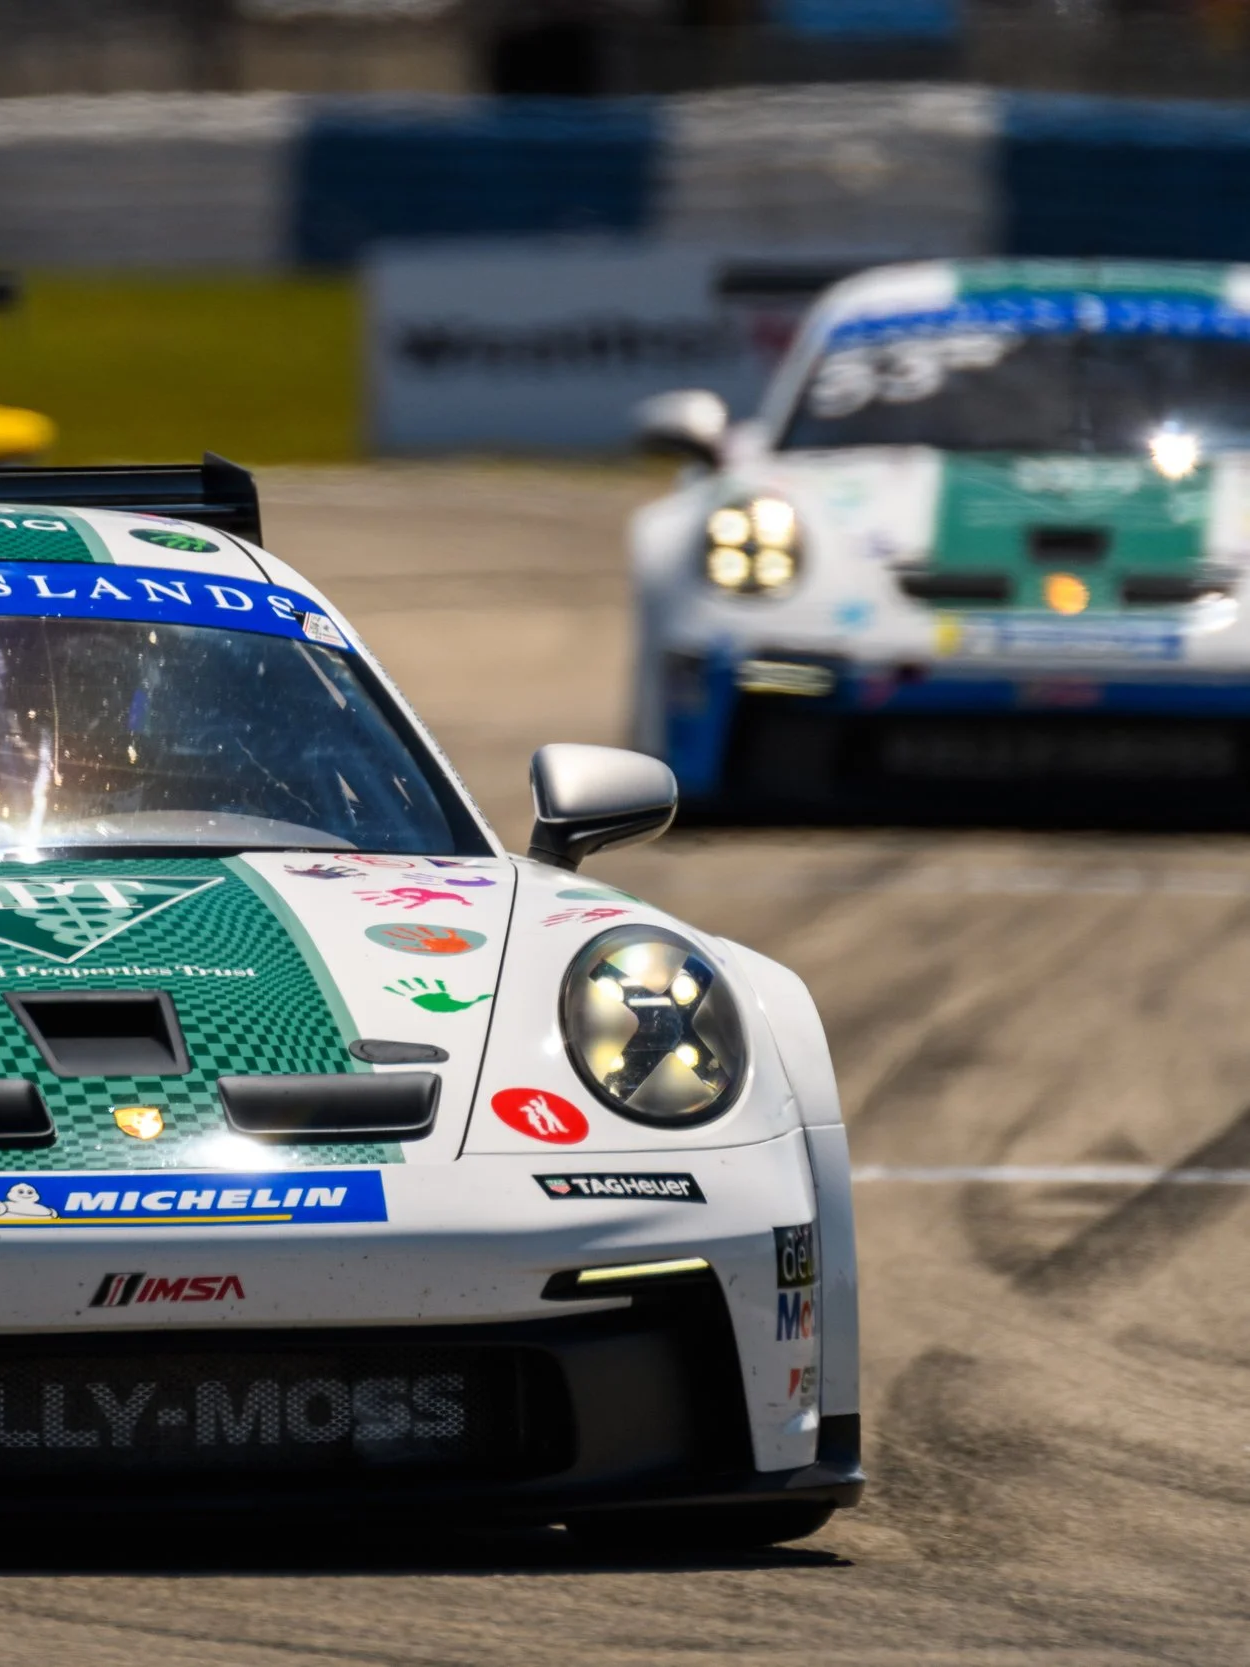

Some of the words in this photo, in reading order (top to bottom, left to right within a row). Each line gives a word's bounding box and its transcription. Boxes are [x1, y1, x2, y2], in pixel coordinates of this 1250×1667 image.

[16, 965, 172, 979] Properties
[175, 965, 257, 978] Trust
[64, 1187, 347, 1212] MICHELIN
[136, 1275, 246, 1303] IMSA
